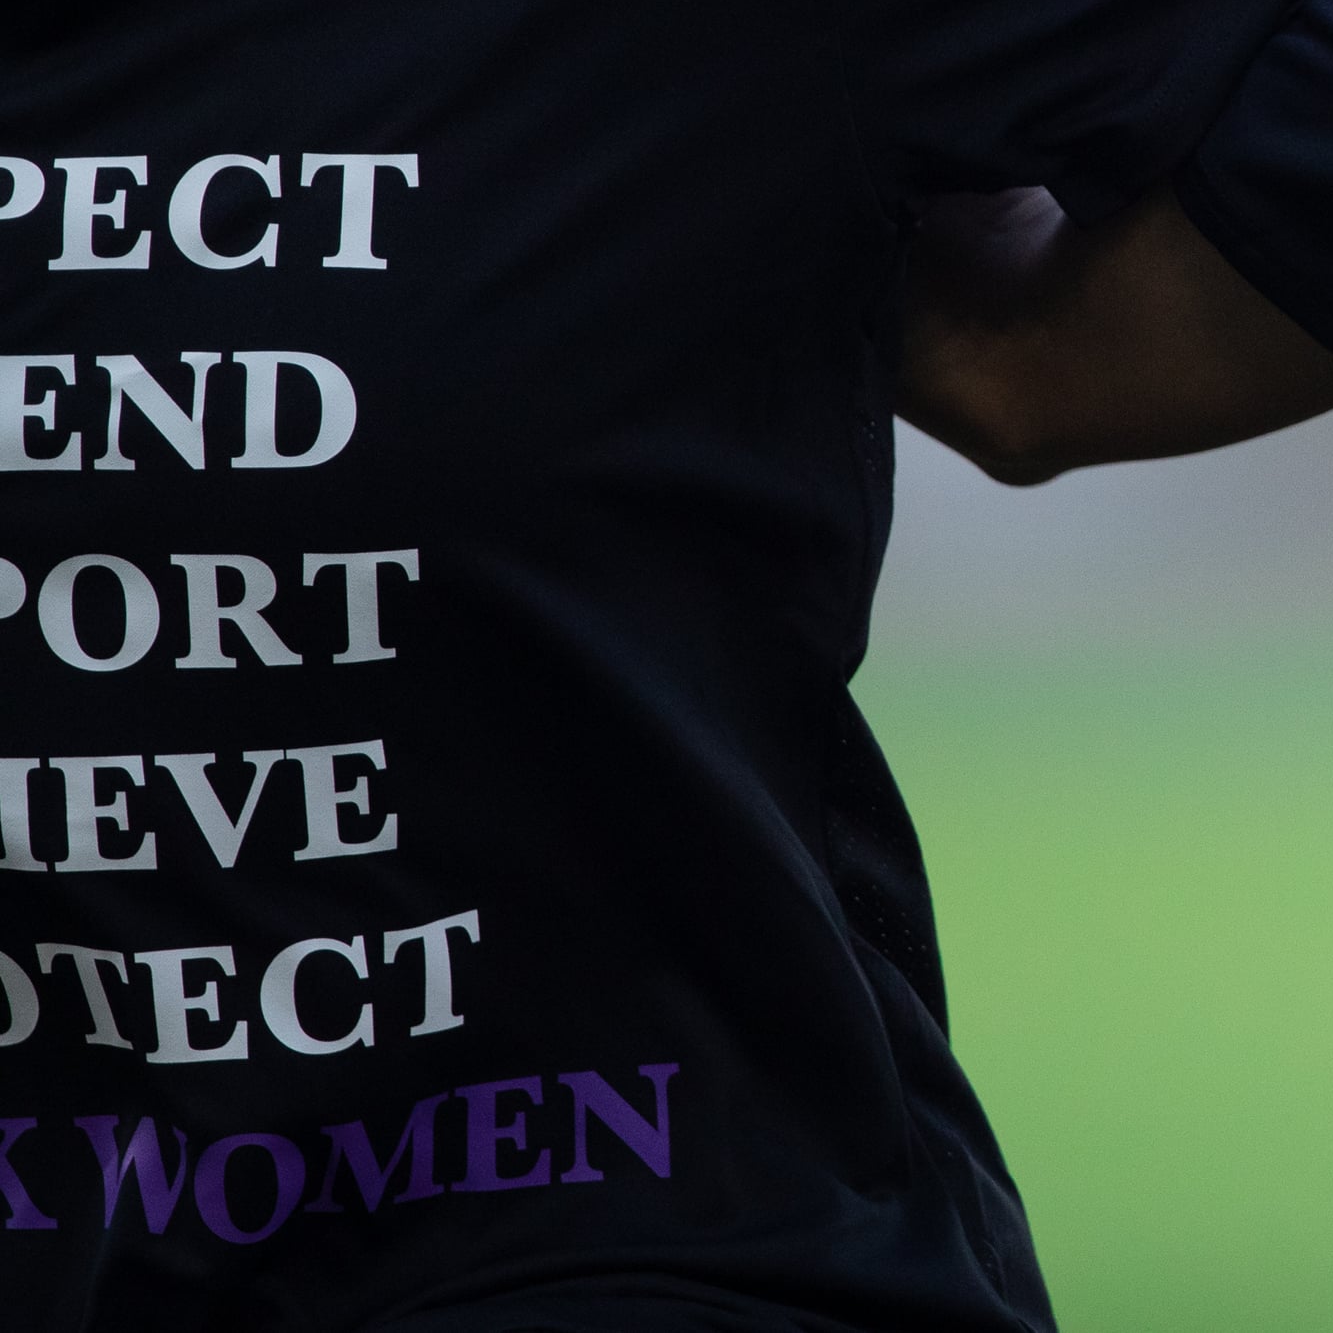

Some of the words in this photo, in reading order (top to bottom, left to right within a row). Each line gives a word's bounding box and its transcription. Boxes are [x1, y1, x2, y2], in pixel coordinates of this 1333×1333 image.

[0, 351, 357, 471] END
[0, 549, 420, 672] ORT
[74, 1063, 681, 1244] WOMEN
